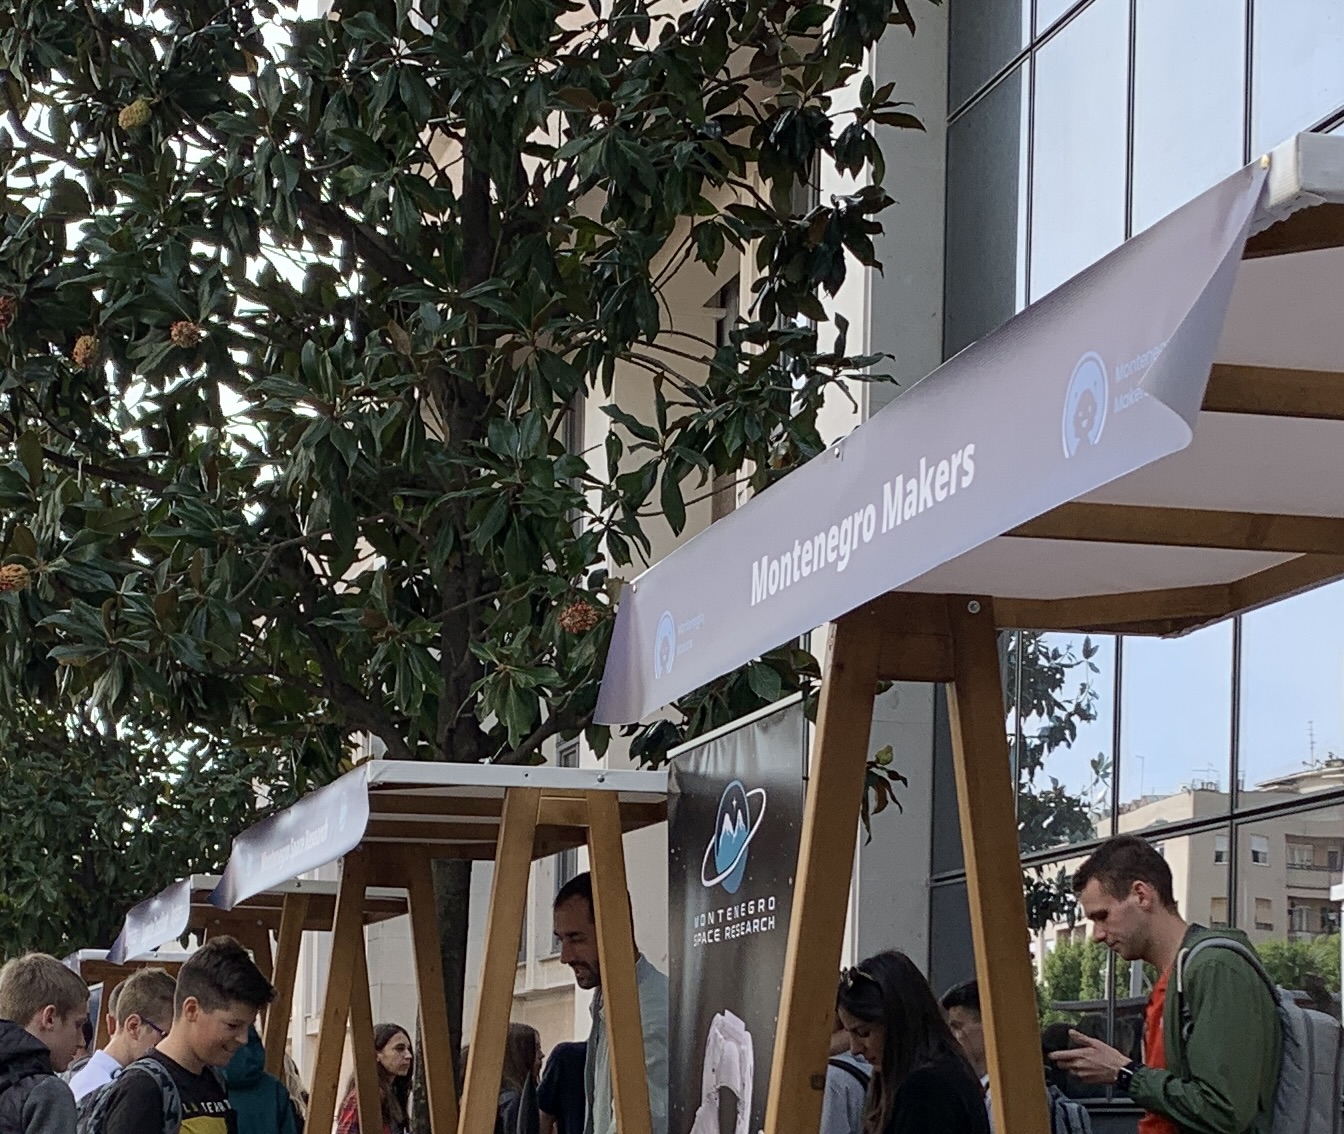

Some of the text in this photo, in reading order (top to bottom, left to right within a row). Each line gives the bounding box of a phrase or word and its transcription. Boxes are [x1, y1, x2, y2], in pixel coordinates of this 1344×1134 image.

[751, 443, 975, 606] Montenegro Makers
[694, 896, 776, 928] MONTENEGRO
[693, 915, 776, 947] SPACE RESEARCH
